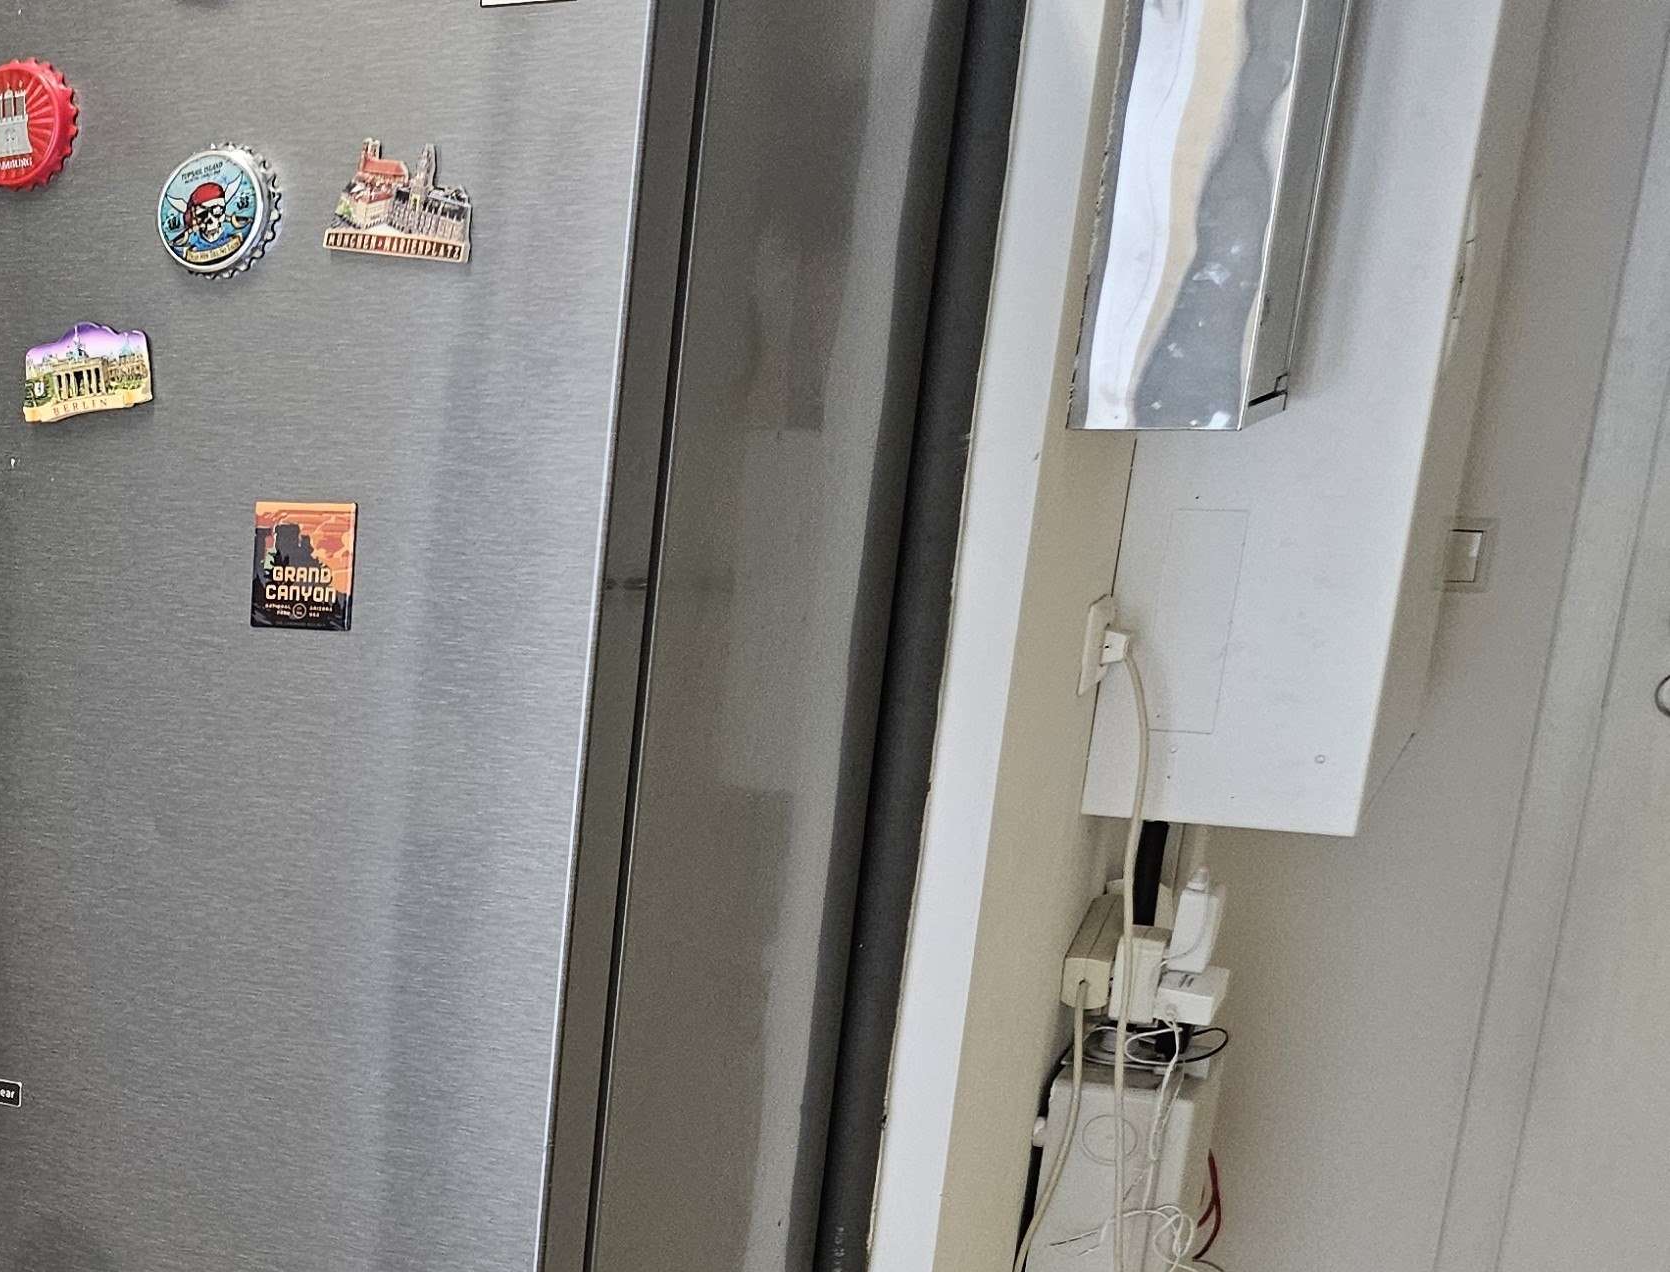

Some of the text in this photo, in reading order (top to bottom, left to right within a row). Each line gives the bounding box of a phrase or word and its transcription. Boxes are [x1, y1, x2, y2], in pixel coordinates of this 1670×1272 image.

[383, 236, 460, 259] MARIENPLATZ
[51, 399, 108, 415] BERLIN
[272, 566, 332, 583] GRAND
[265, 584, 336, 603] CANYON
